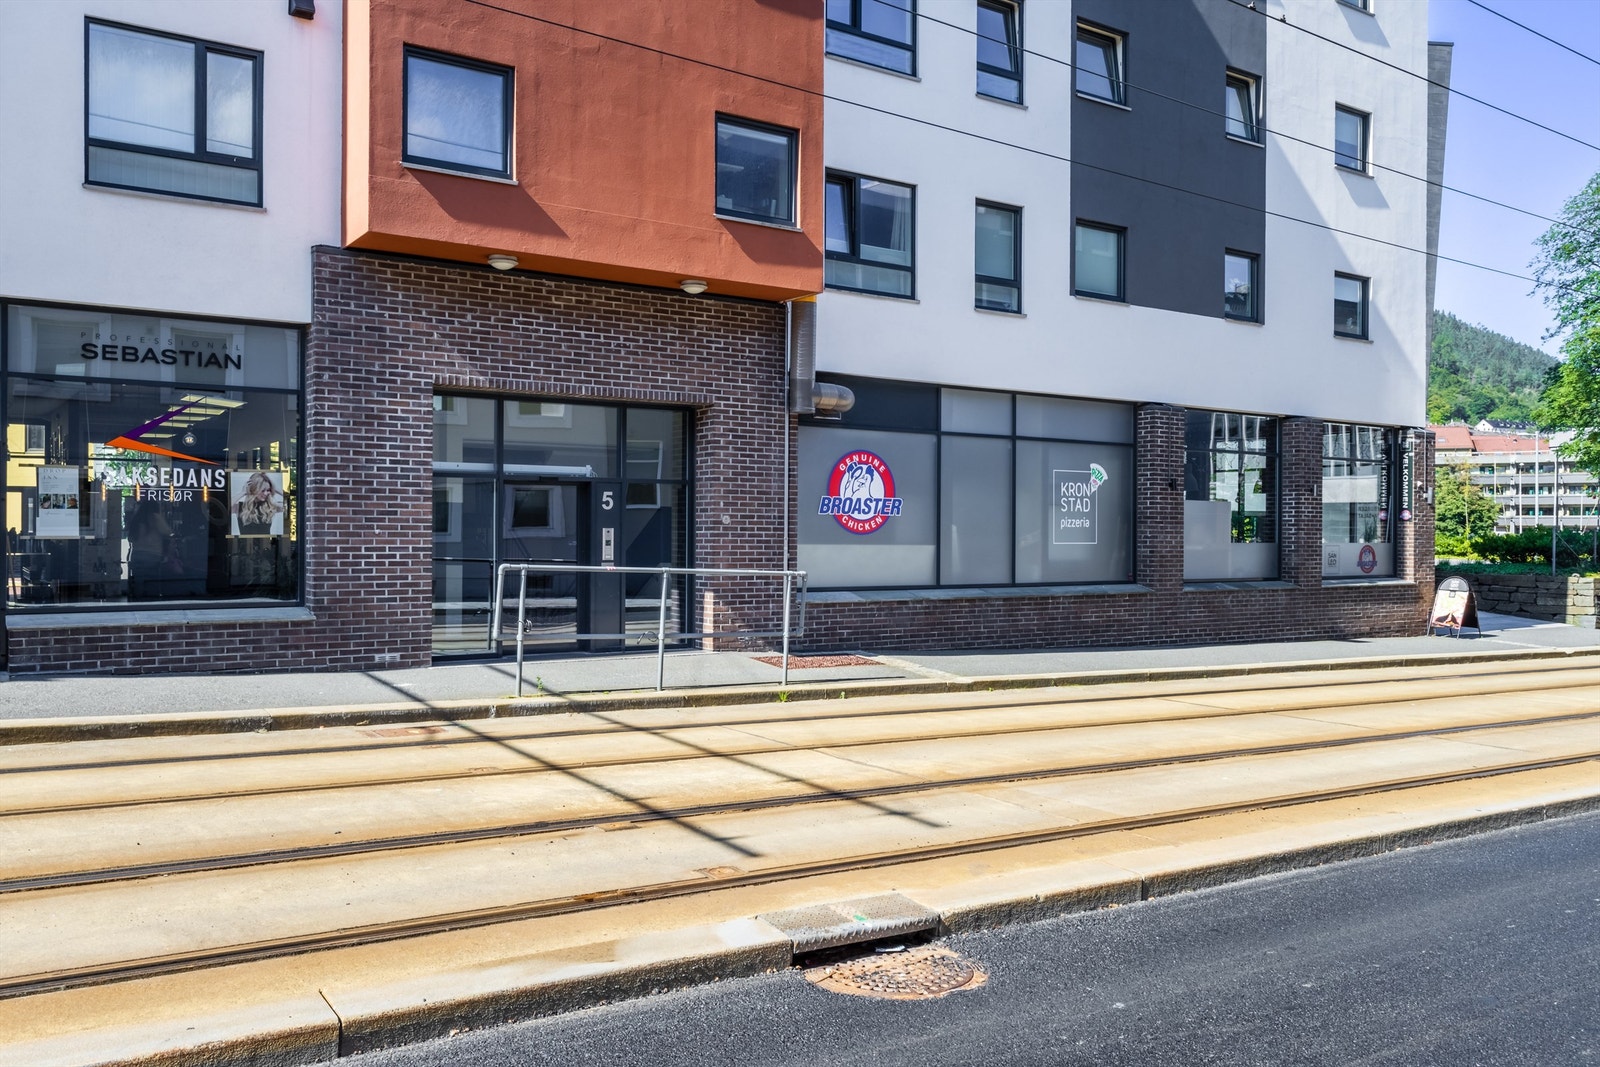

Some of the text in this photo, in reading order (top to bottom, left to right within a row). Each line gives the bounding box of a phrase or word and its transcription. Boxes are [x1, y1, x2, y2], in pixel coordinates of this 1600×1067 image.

[80, 331, 241, 351] PROFESSIONAL
[80, 342, 242, 370] SEBASTIAN
[839, 454, 886, 473] GENUINE
[104, 466, 225, 488] SAKSEDANS
[138, 489, 193, 502] FRISØR
[1061, 482, 1091, 497] KRON
[601, 491, 614, 510] 5
[818, 496, 904, 516] BROASTER
[1060, 497, 1091, 512] STAD
[842, 516, 883, 531] CHICKEN
[1060, 516, 1090, 530] pizzeria
